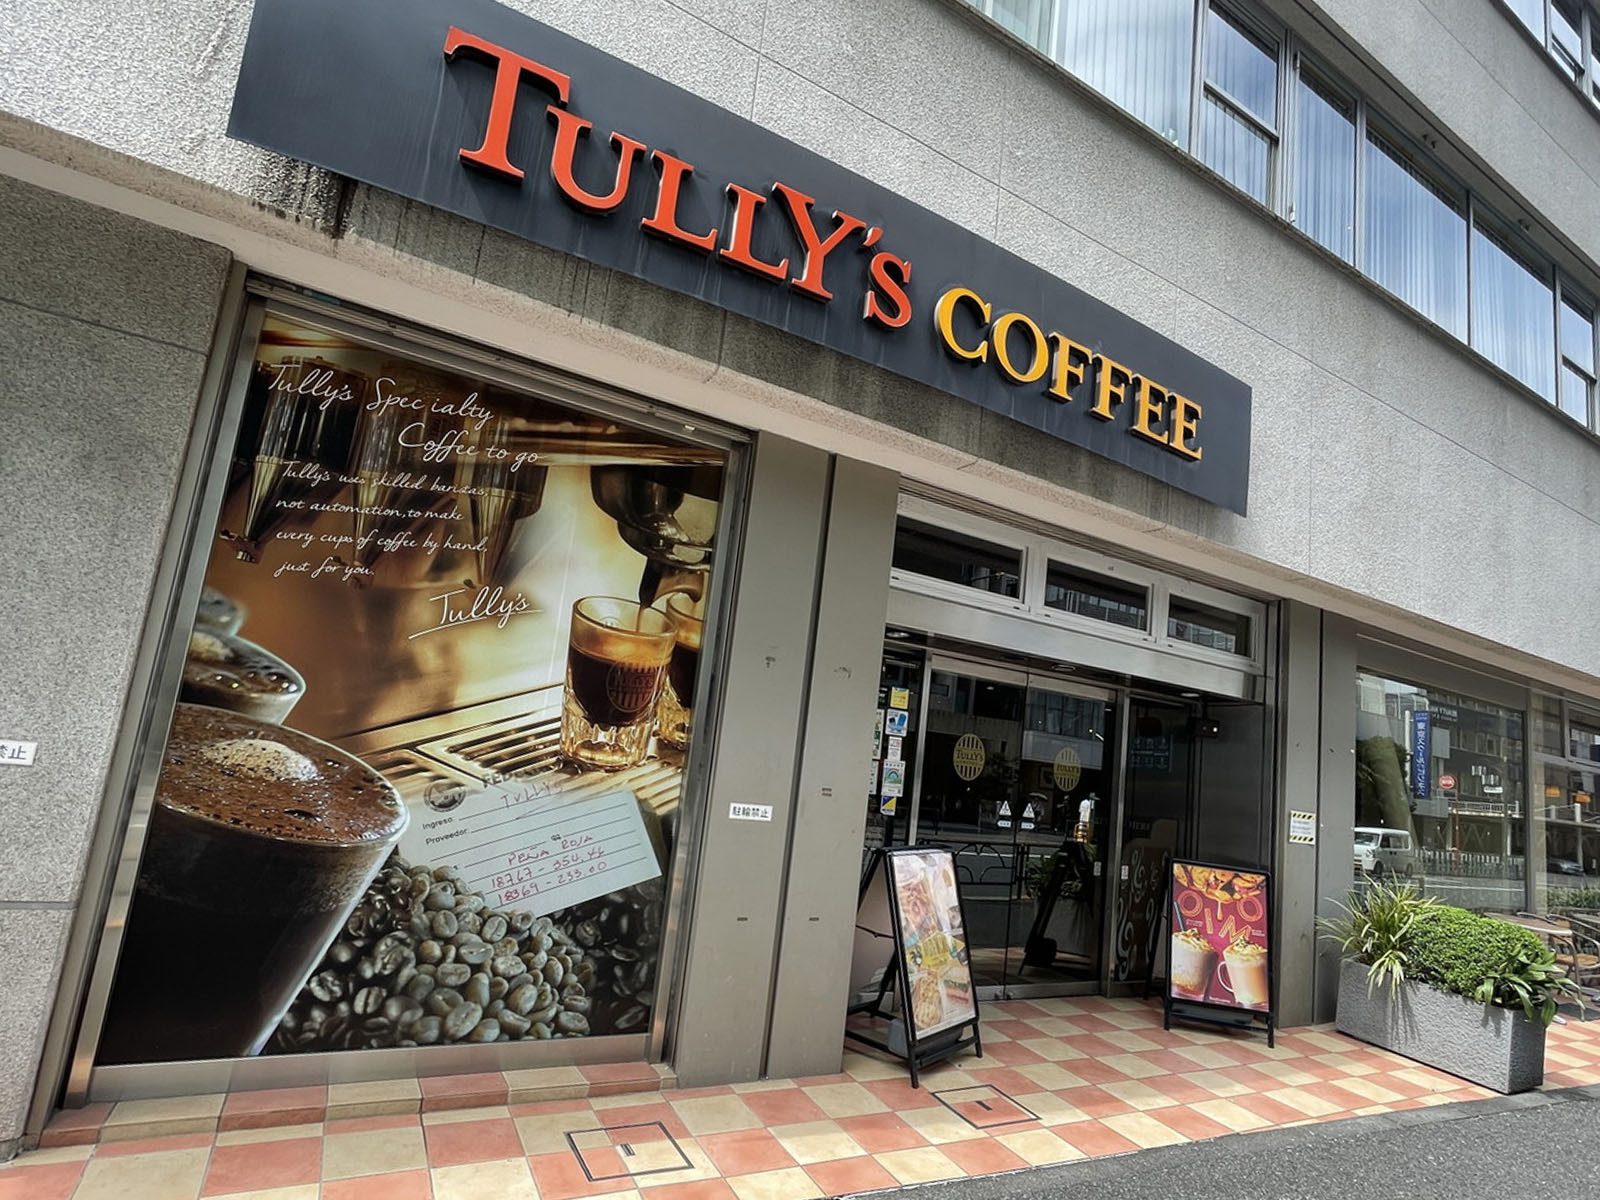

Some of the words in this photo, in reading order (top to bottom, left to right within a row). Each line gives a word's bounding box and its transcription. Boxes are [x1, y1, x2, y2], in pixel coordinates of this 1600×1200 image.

[443, 26, 912, 328] TULLY'S
[934, 287, 1203, 461] COFFEE
[268, 363, 354, 410] Tully's
[398, 422, 479, 462] Coffee
[486, 444, 508, 461] to
[514, 450, 541, 472] go
[281, 460, 330, 487] Tully's
[371, 472, 426, 491] skilled
[275, 499, 305, 511] not
[425, 505, 464, 521] make
[275, 530, 315, 549] every
[319, 534, 354, 550] cups
[356, 528, 379, 550] of
[376, 531, 419, 552] coffee
[422, 533, 440, 556] by
[443, 536, 489, 553] hand,
[273, 562, 311, 578] just
[310, 556, 339, 579] for
[344, 565, 375, 582] you.
[428, 585, 530, 629] Tully's
[733, 806, 769, 818] 駐輪禁止
